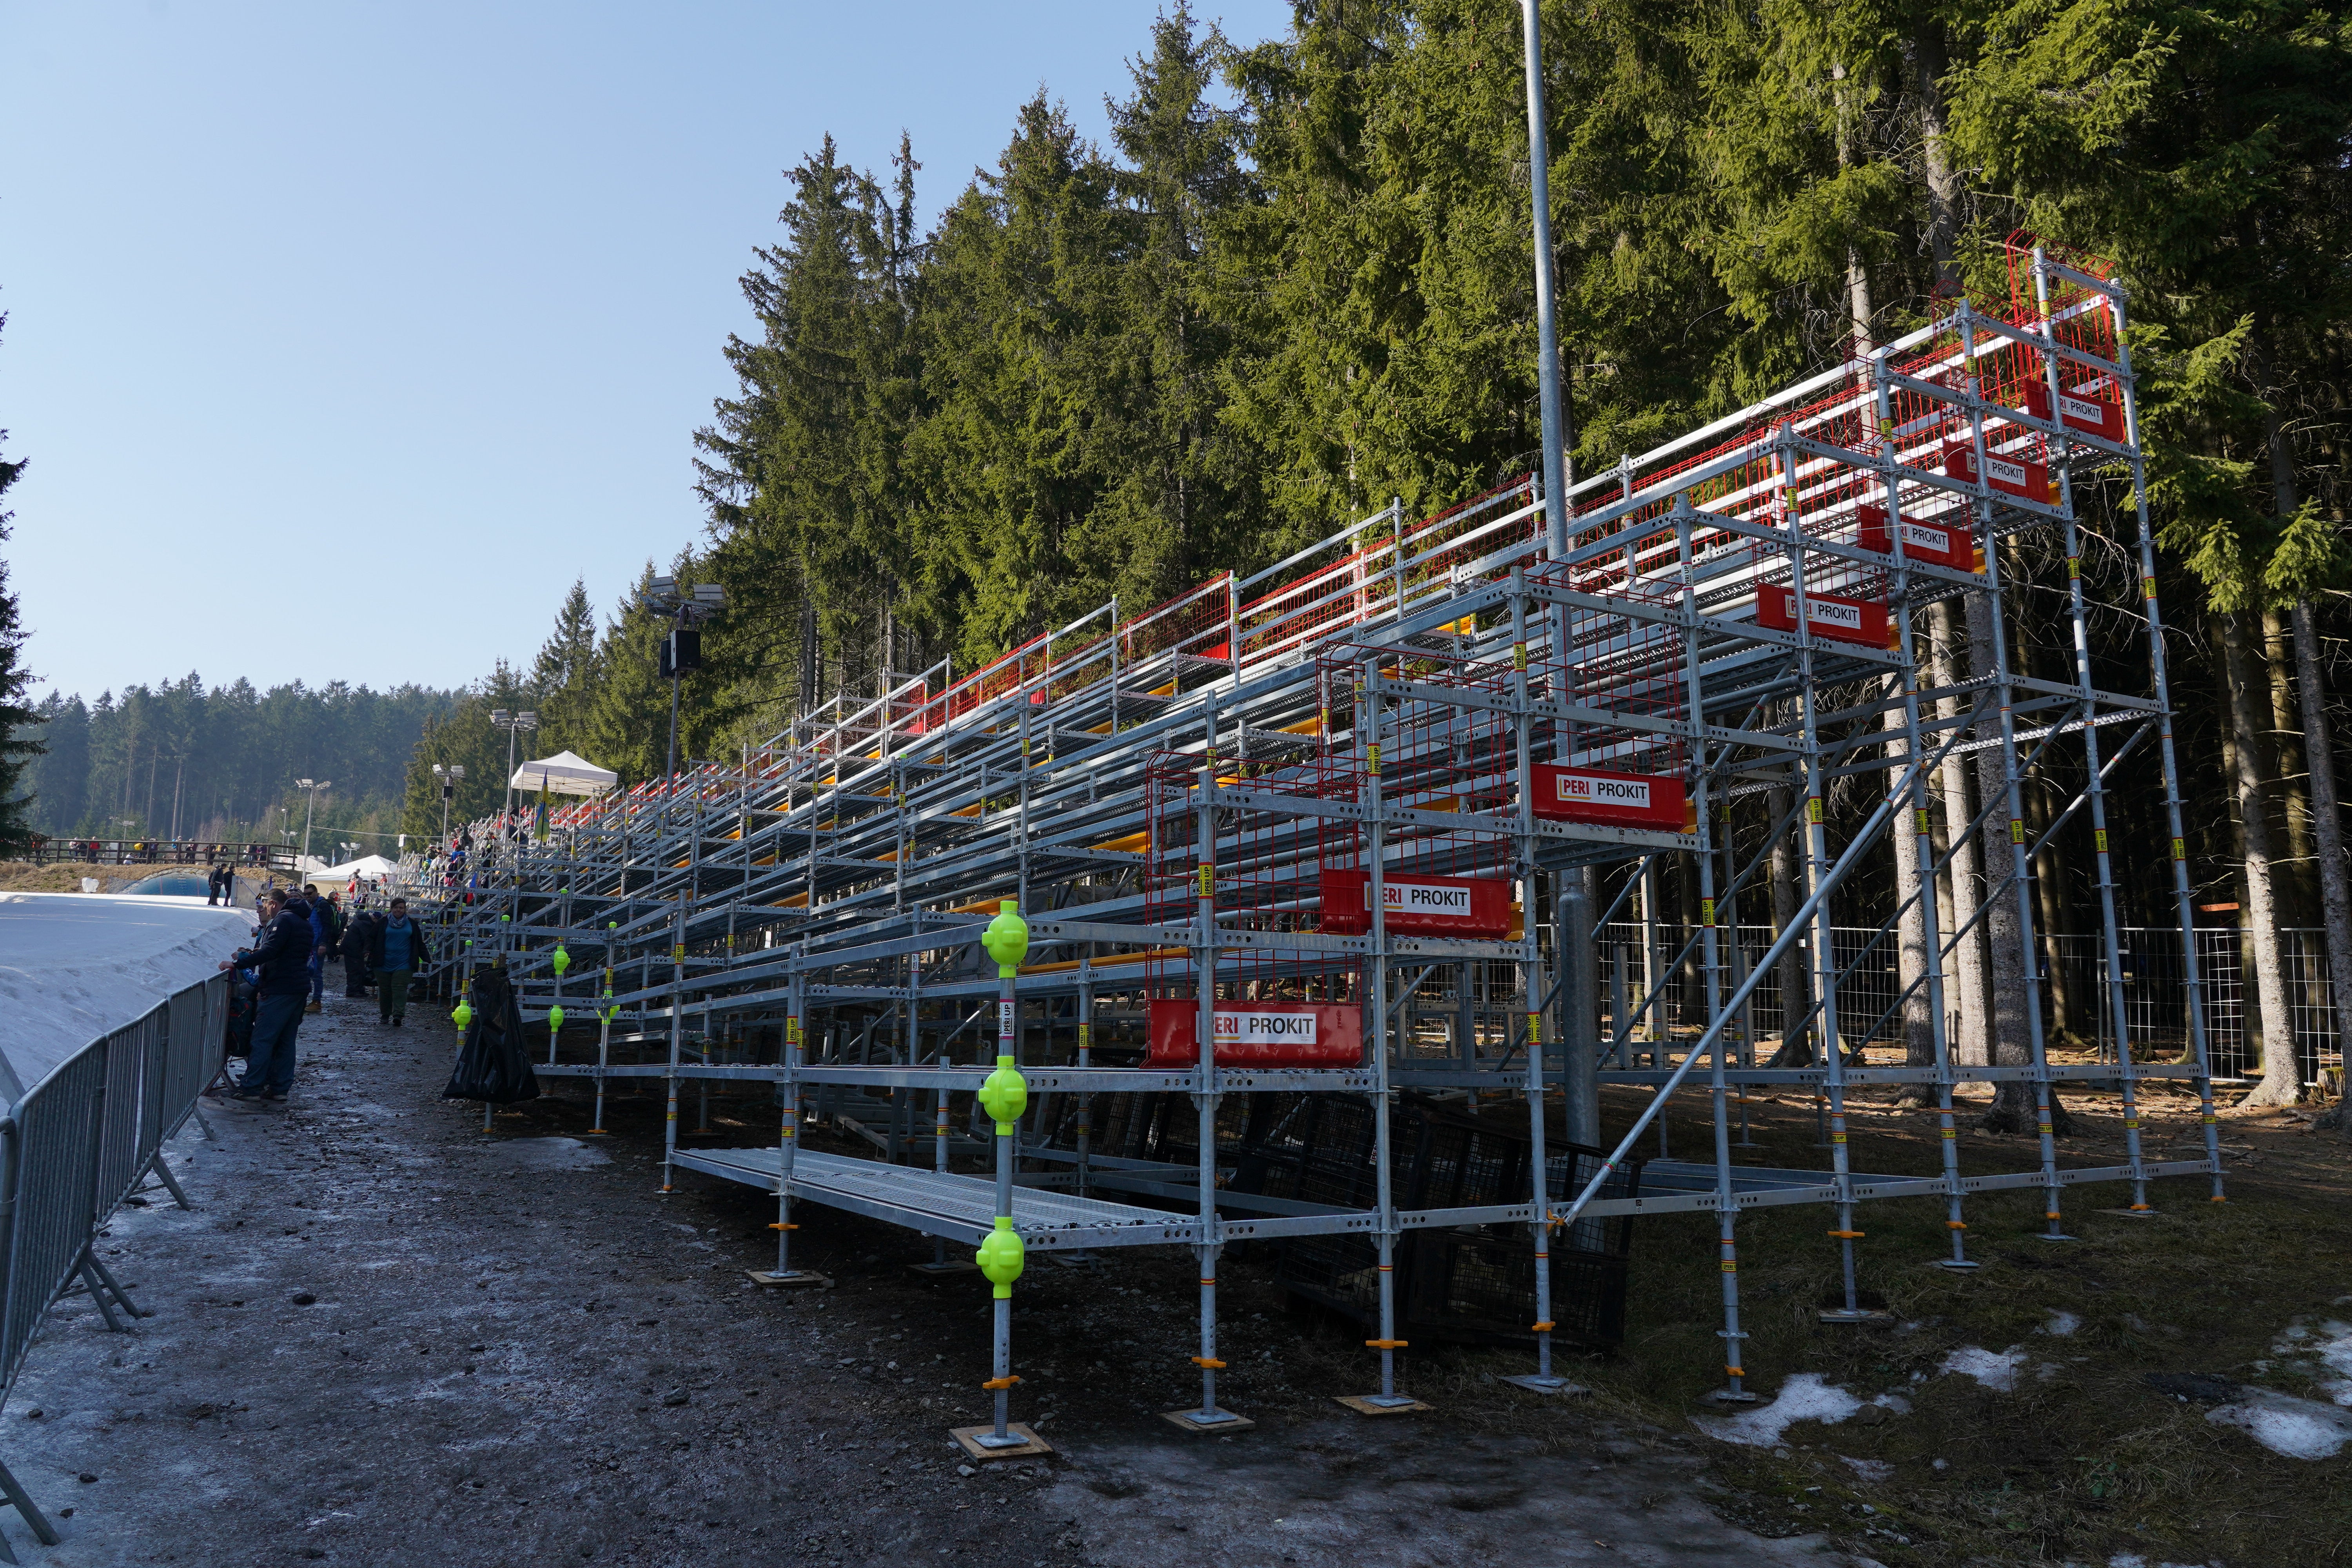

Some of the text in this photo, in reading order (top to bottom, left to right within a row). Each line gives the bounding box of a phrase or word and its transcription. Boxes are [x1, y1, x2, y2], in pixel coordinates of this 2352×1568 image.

[2071, 401, 2100, 418] PROKIT
[1993, 462, 2023, 479] PROKIT
[1913, 528, 1946, 545] PROKIT
[1684, 566, 1689, 574] UP
[1818, 604, 1857, 621] PROKIT
[1516, 646, 1521, 654] UP
[1374, 748, 1379, 757] UP
[1563, 779, 1647, 799] PERI PROKIT
[1204, 867, 1210, 877] UP
[1383, 887, 1468, 906] ERI PROKIT
[1703, 902, 1708, 910] UP
[1004, 1004, 1011, 1016] UP
[790, 1019, 795, 1027] UP
[1215, 1017, 1313, 1034] ERI PROKIT
[1527, 1016, 1532, 1025] UP
[1535, 1016, 1540, 1025] UP
